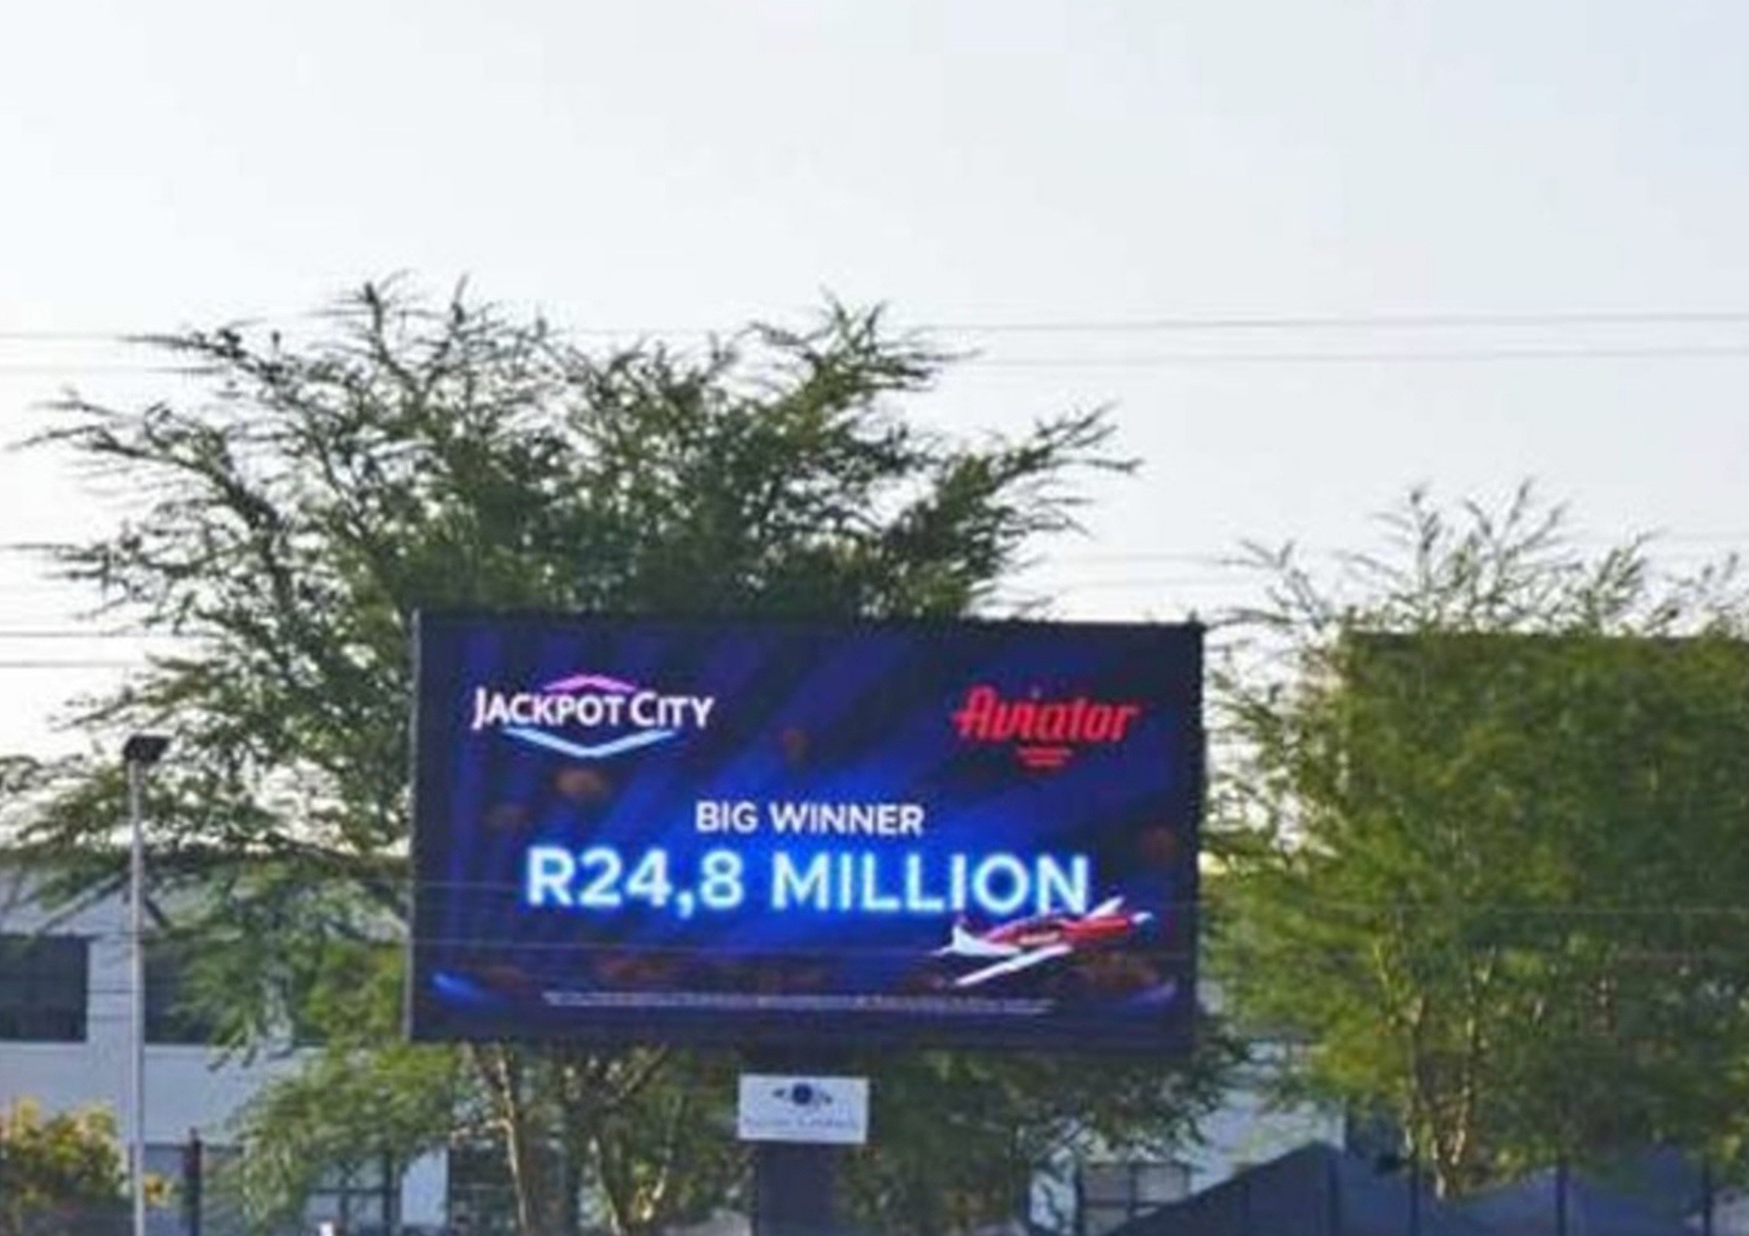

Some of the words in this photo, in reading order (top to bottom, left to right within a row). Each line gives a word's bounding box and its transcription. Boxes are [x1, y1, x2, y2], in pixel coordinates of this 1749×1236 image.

[951, 684, 1141, 742] Aviator
[695, 800, 759, 833] BIG
[769, 802, 925, 836] WINNER
[527, 846, 744, 919] R24,8
[772, 852, 1088, 914] MILLION
